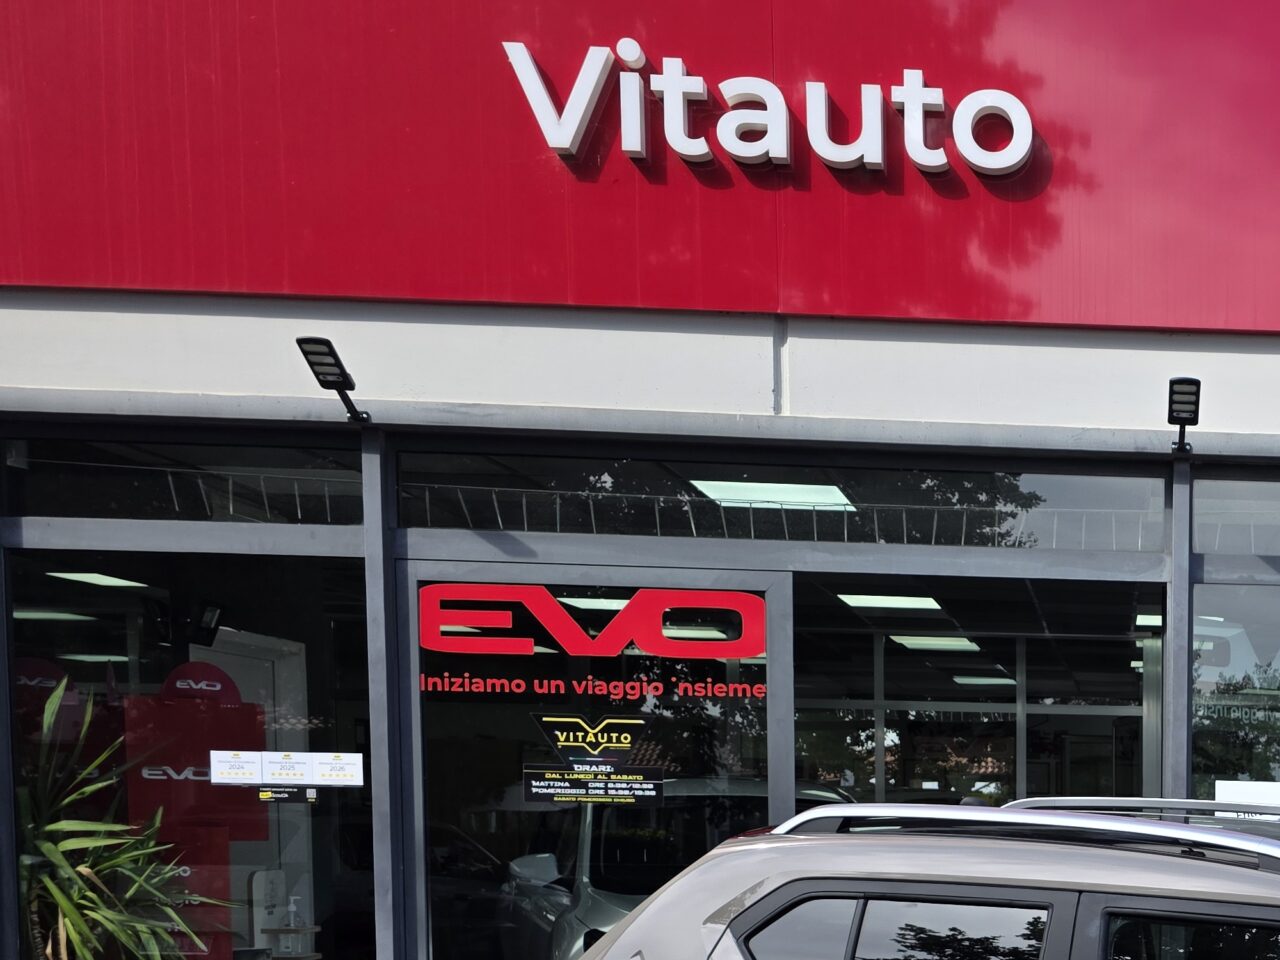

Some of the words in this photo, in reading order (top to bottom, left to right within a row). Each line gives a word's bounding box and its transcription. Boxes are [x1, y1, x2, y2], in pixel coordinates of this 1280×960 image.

[502, 37, 1033, 175] Vitauto
[419, 583, 766, 659] EVO
[175, 679, 222, 691] EVO
[420, 673, 526, 694] Iniziamo
[534, 678, 566, 694] un
[571, 674, 665, 700] viaggio
[557, 731, 632, 743] VITAUTO
